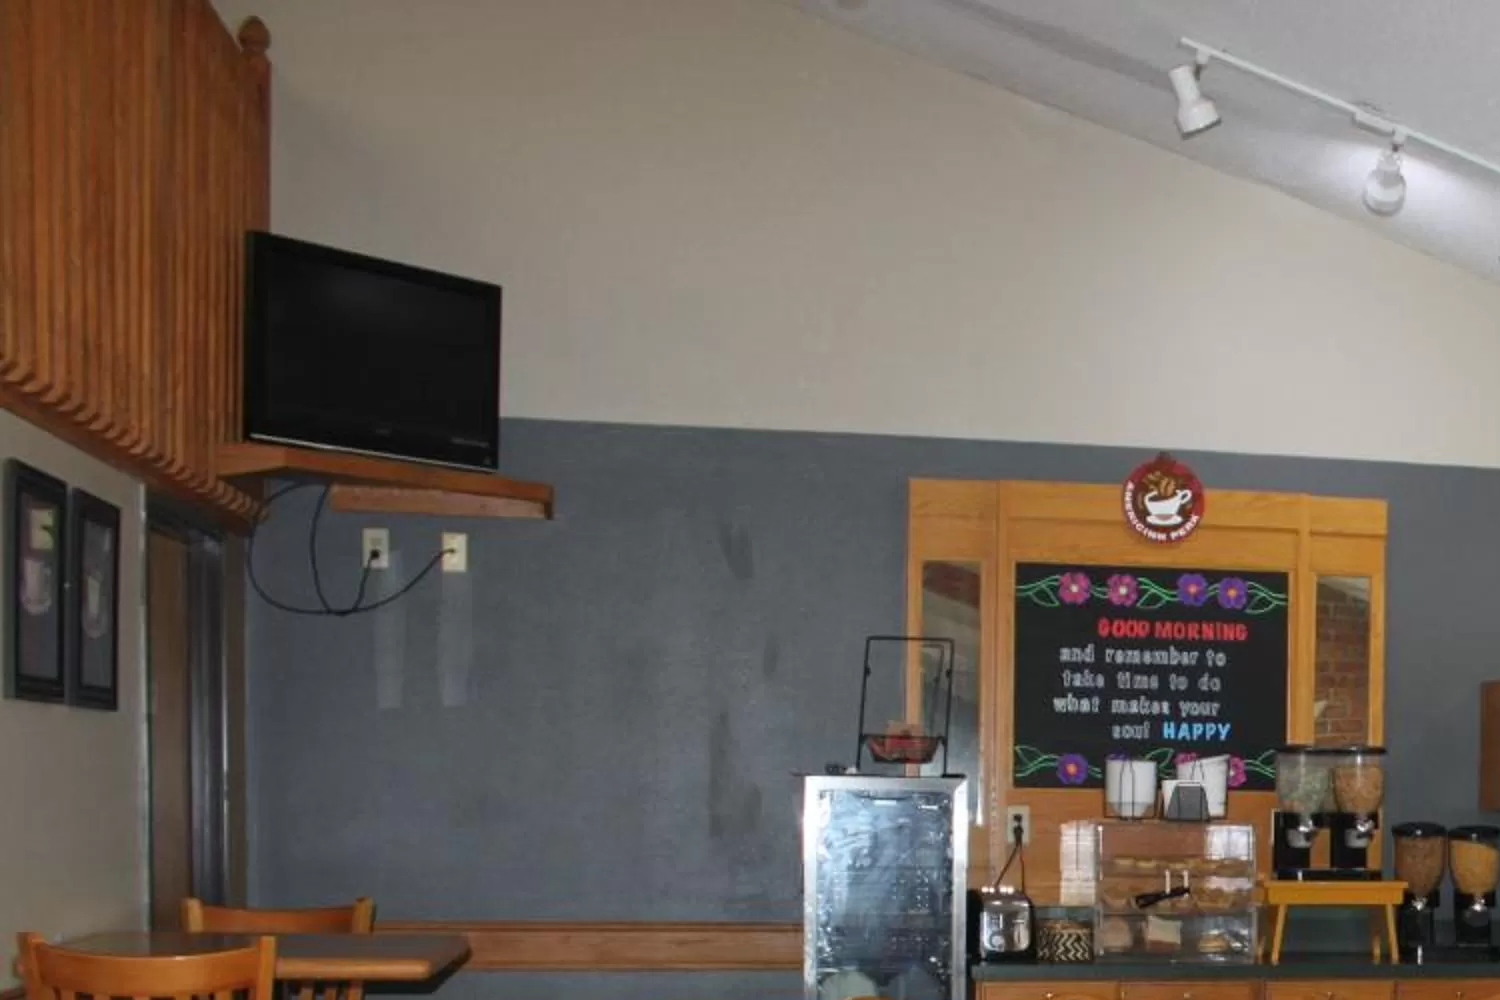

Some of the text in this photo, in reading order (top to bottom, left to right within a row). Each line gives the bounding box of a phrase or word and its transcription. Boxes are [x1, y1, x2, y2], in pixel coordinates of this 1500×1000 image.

[1097, 617, 1249, 641] GOOD MORNING
[1059, 643, 1227, 667] and remember to
[1062, 669, 1221, 691] take time to do
[1052, 692, 1221, 717] what makes your
[1112, 721, 1232, 741] soul HAPPY
